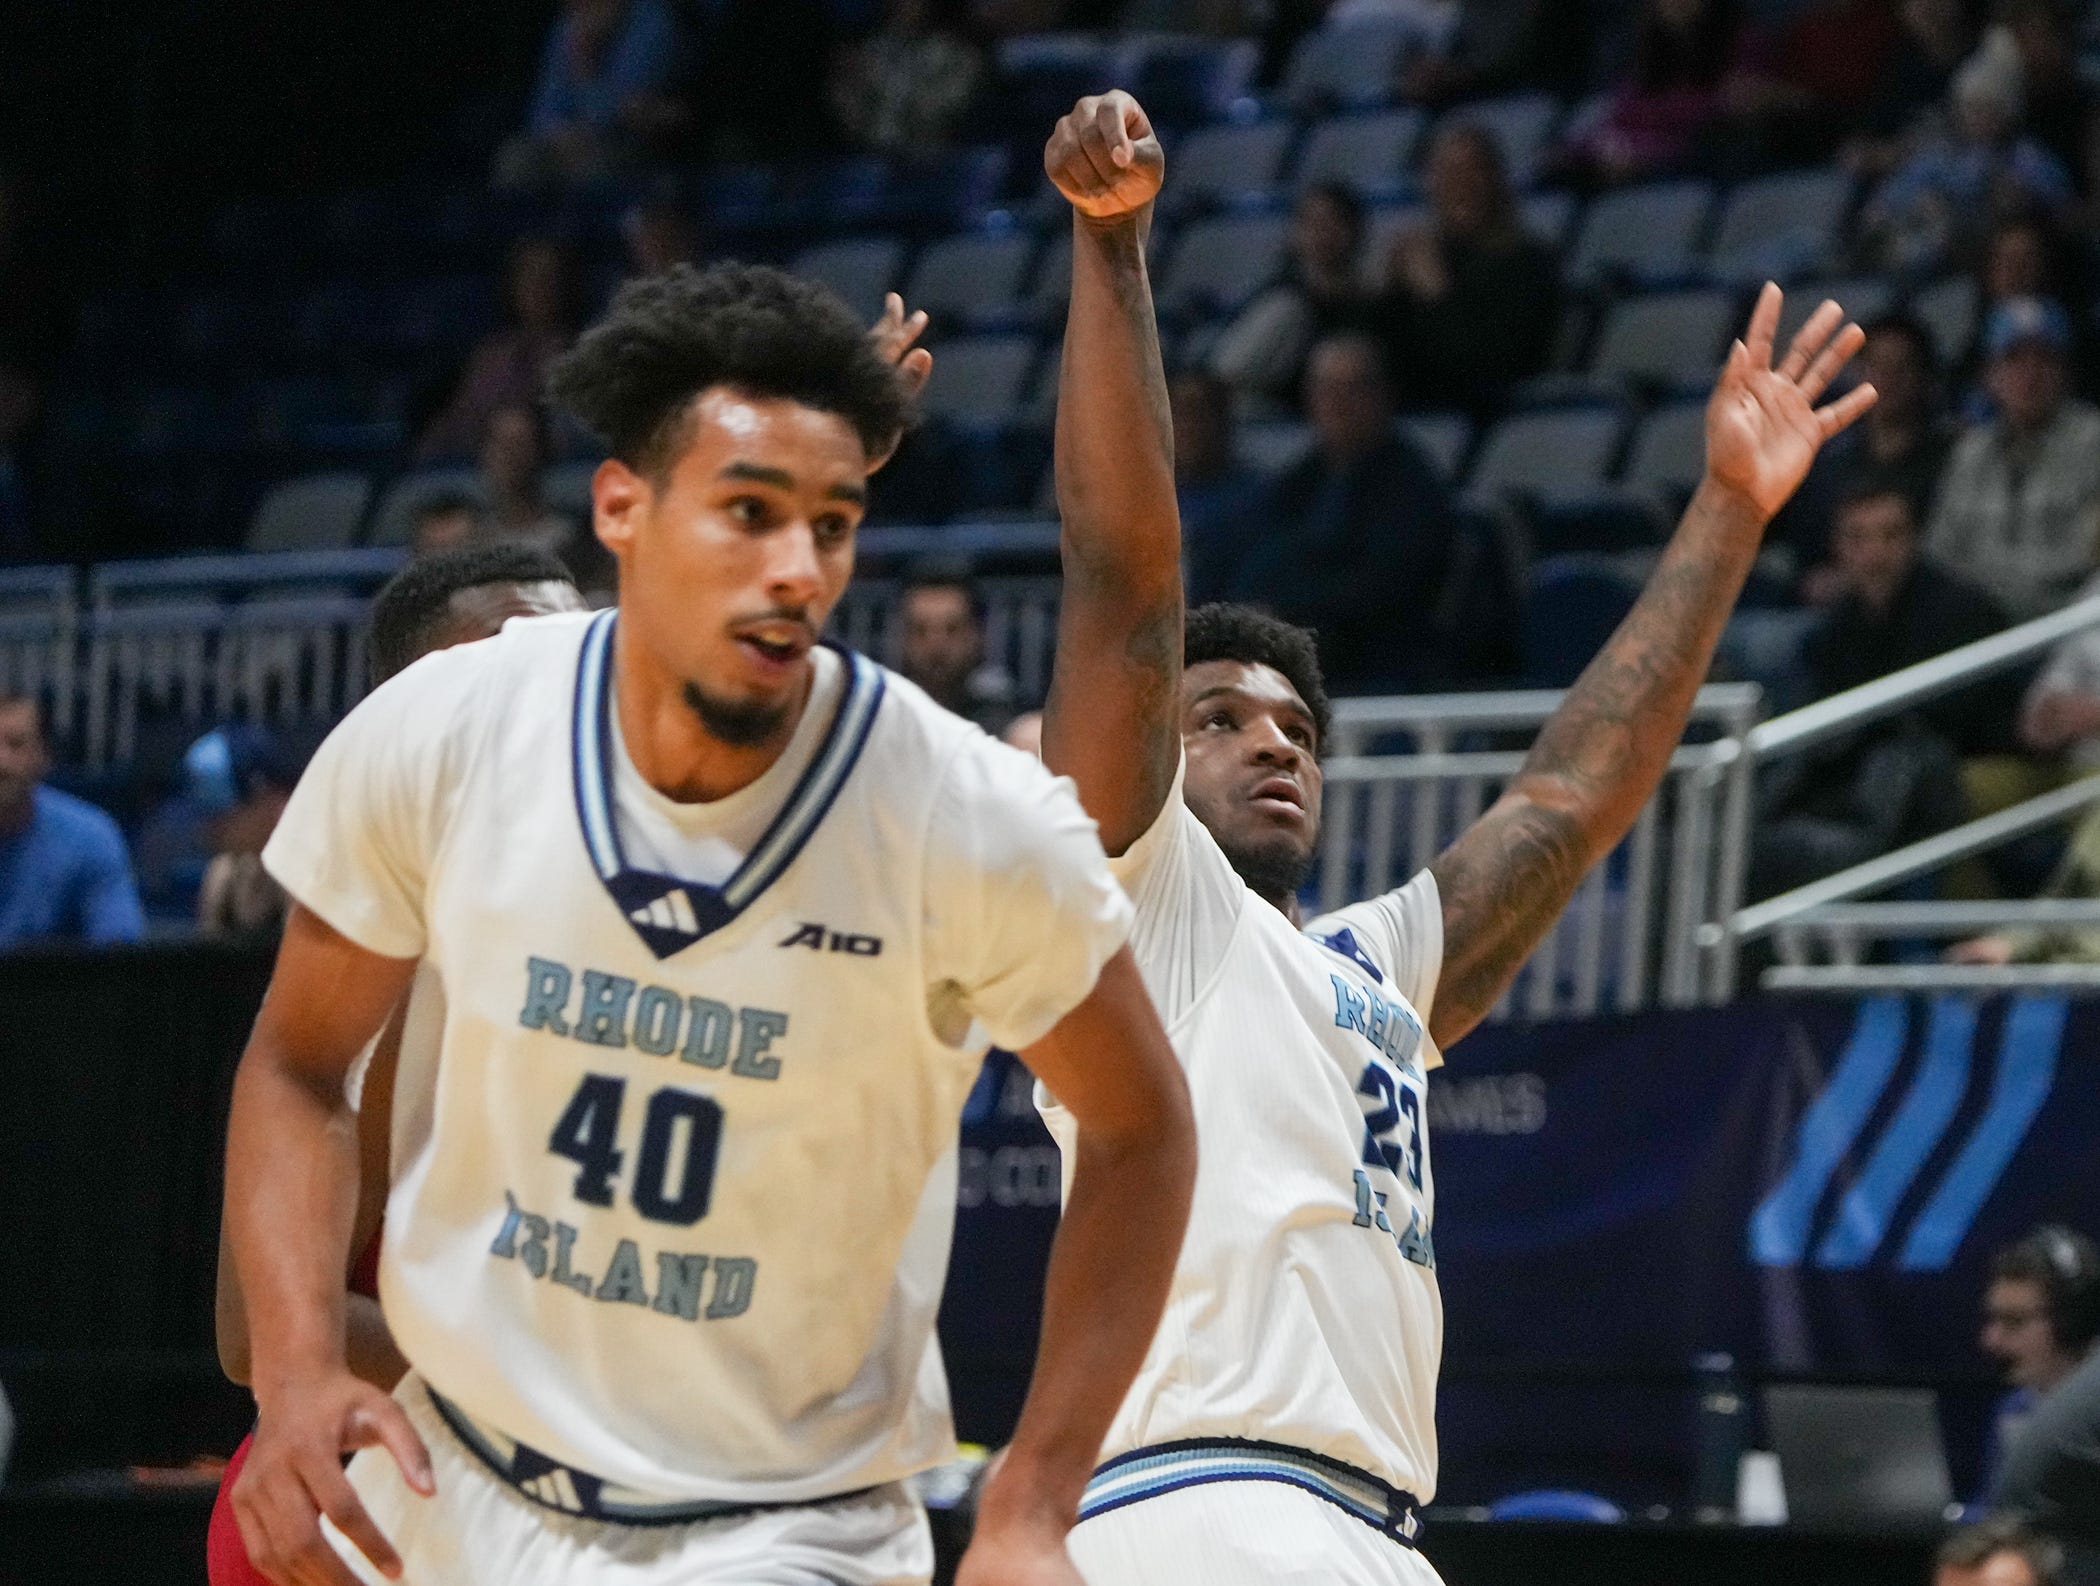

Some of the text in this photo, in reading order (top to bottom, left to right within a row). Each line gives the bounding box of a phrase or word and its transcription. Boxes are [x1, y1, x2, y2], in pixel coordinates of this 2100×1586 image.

[519, 956, 788, 1081] RHODE
[547, 1072, 725, 1227] 40
[1358, 1061, 1423, 1194] 23
